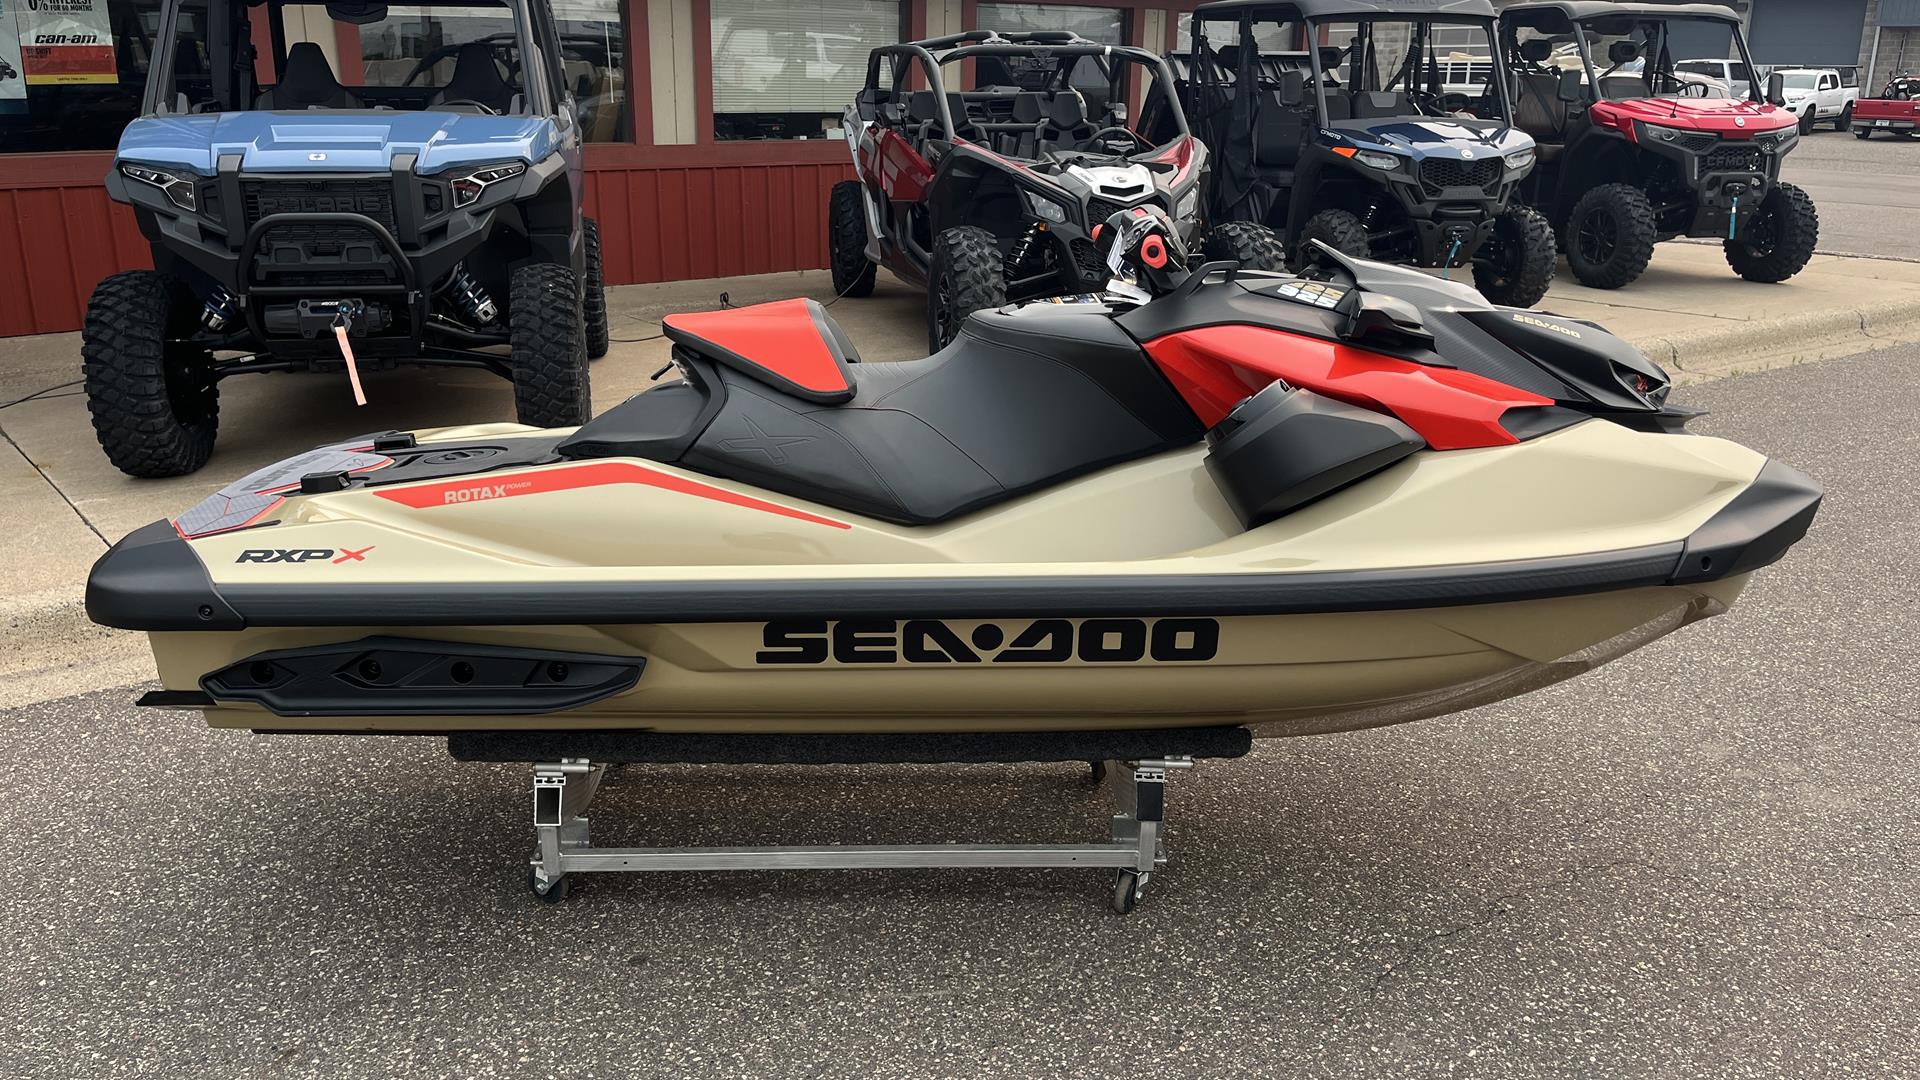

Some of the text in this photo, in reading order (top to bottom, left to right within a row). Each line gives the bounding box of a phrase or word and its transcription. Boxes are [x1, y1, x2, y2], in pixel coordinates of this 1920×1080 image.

[35, 34, 97, 44] can-am
[1320, 129, 1342, 141] CFMOTO
[1706, 155, 1761, 167] CFMOTO
[259, 196, 382, 212] POLARIS
[444, 481, 532, 504] ROTAX POWER
